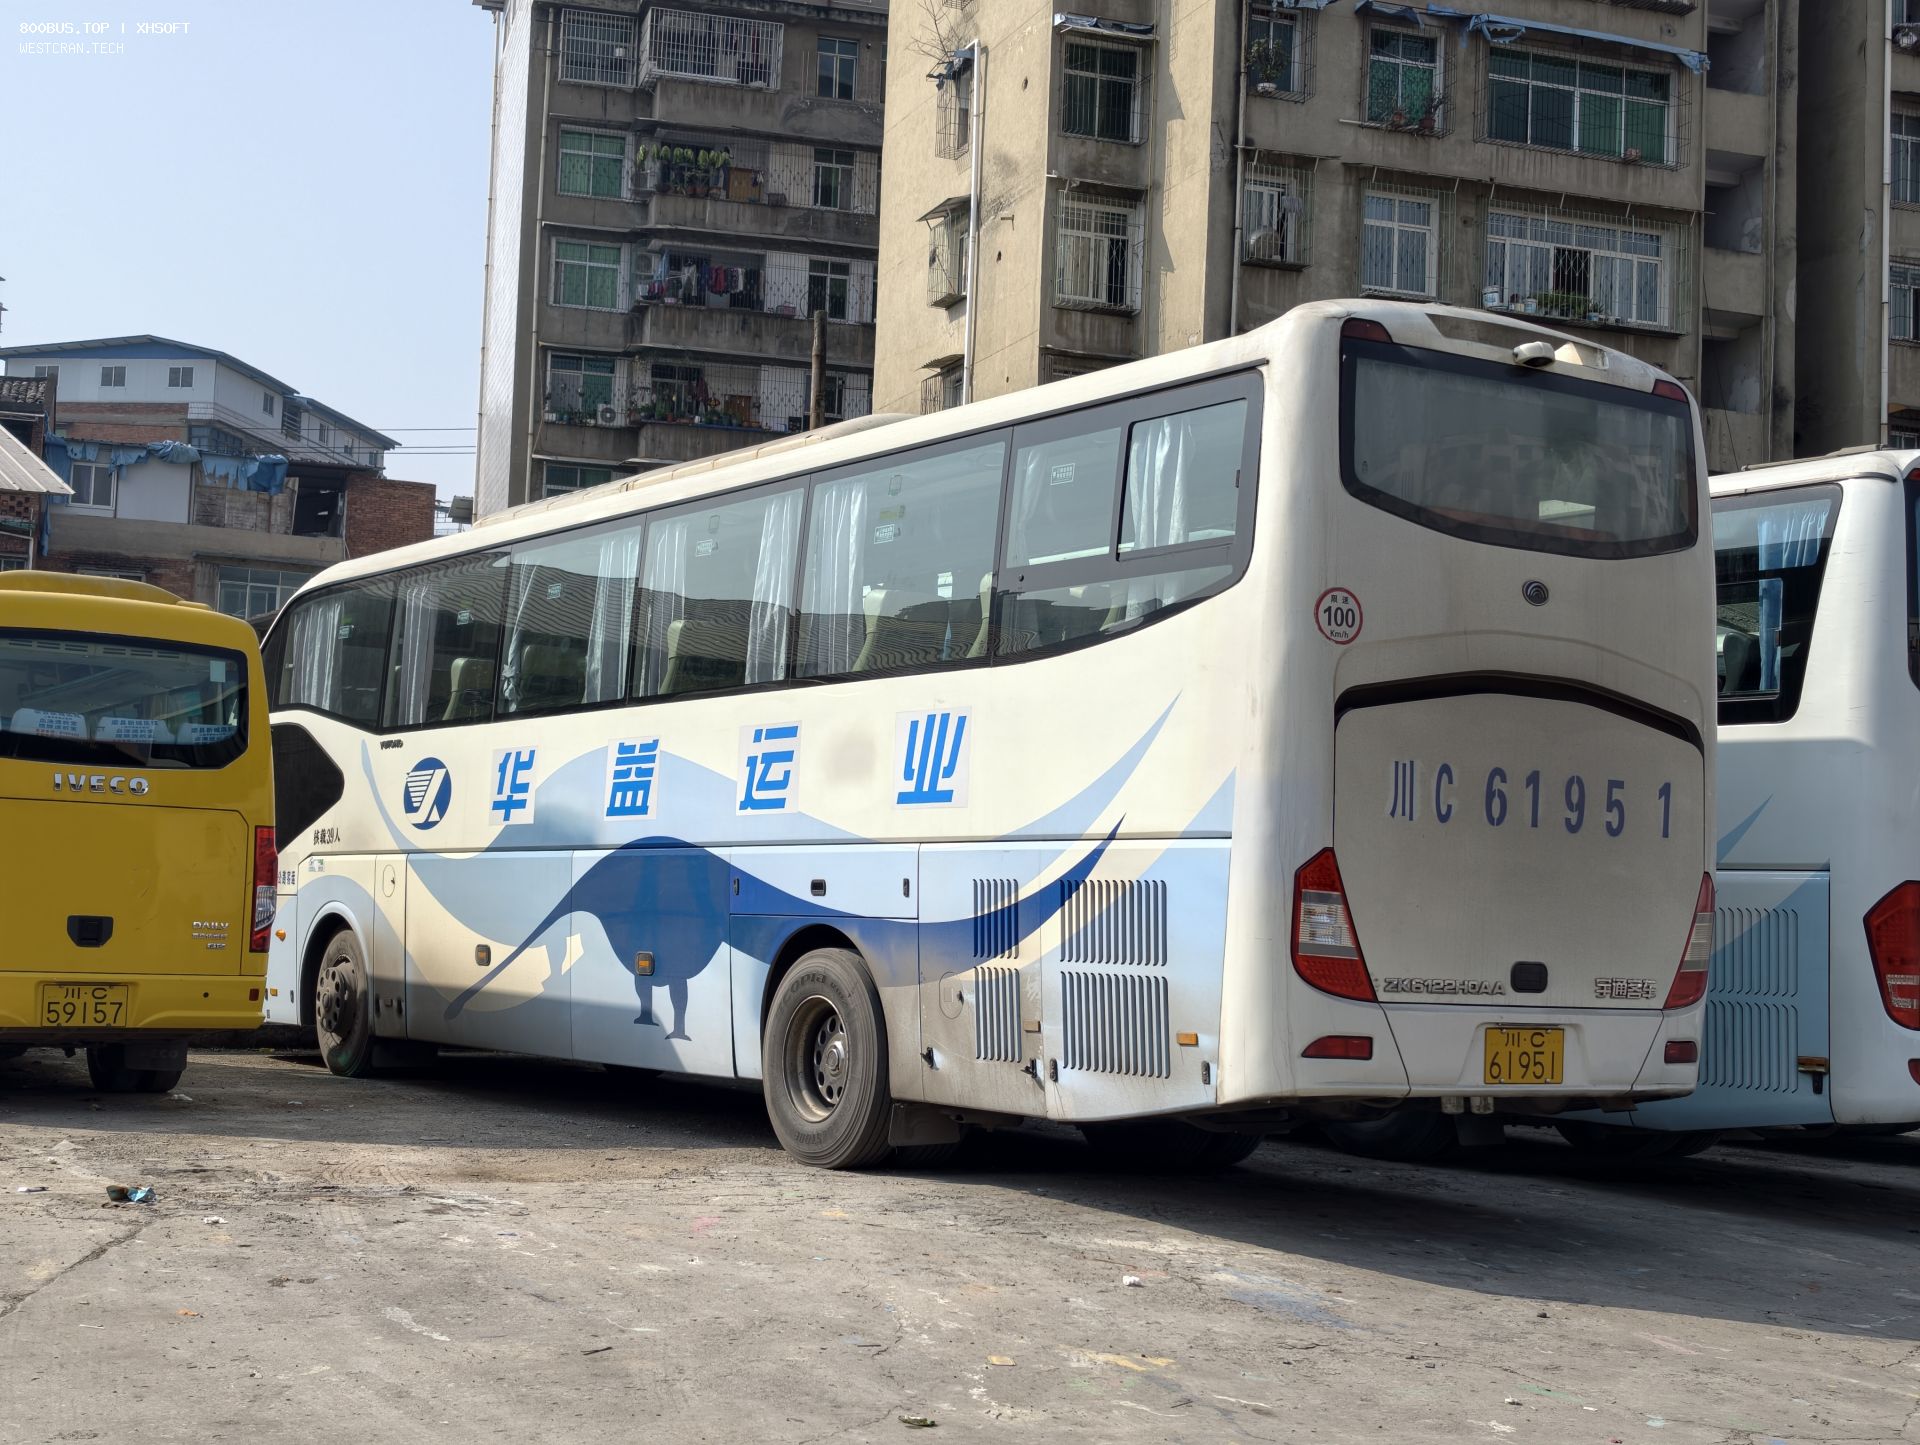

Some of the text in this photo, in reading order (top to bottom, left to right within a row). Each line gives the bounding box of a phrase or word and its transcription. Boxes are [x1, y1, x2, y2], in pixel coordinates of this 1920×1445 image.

[1323, 605, 1356, 628] 100
[1330, 629, 1349, 638] Km/h
[53, 773, 149, 796] IVECO
[192, 920, 230, 930] DAILY
[1594, 977, 1657, 1000] 宇通客车
[46, 1001, 123, 1024] 59157
[1489, 1051, 1555, 1080] 61951
